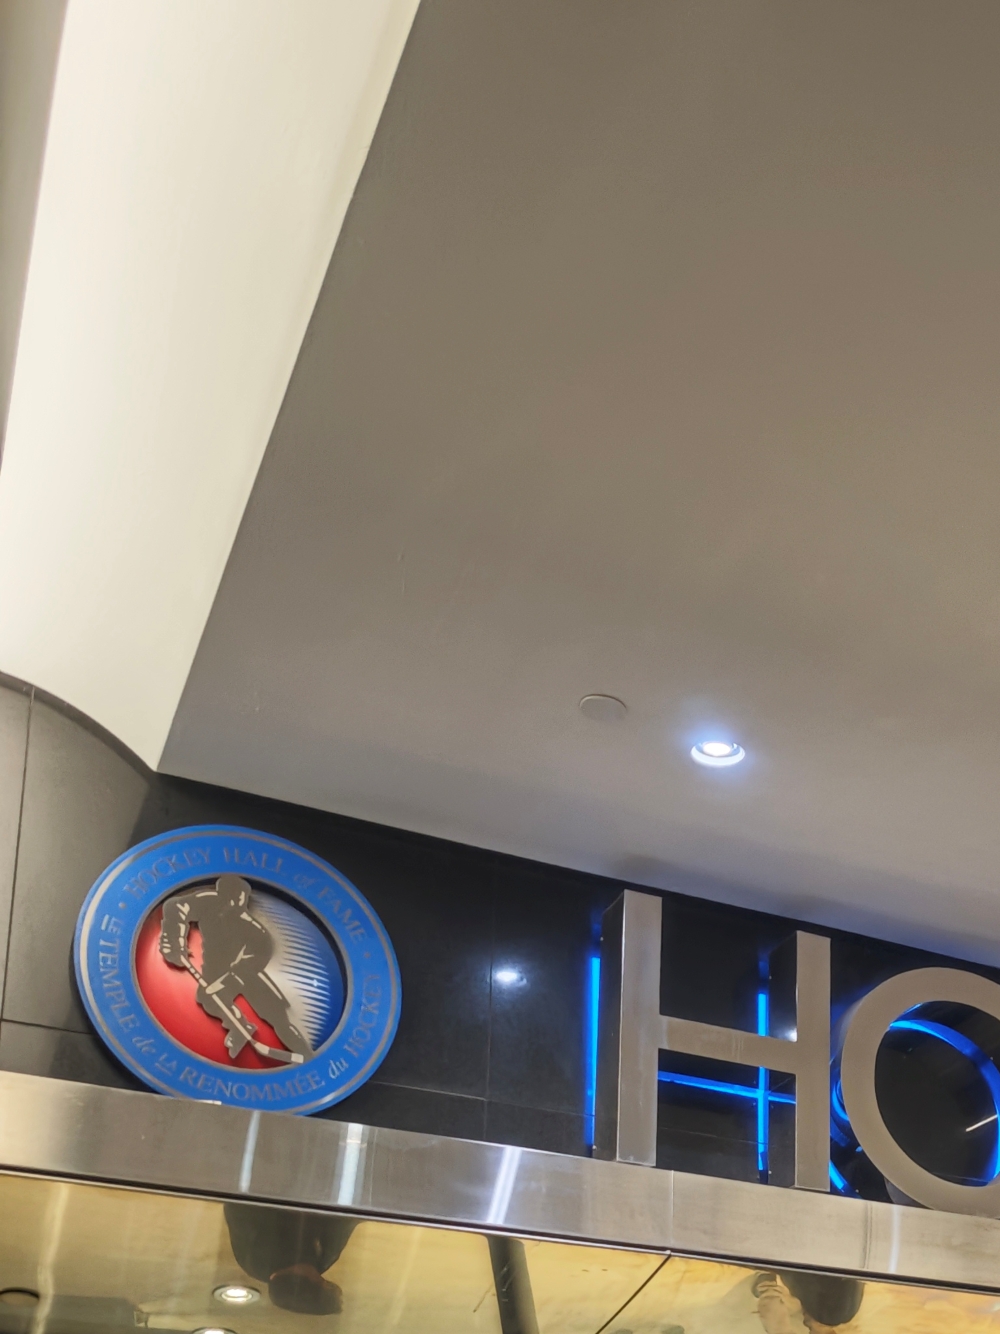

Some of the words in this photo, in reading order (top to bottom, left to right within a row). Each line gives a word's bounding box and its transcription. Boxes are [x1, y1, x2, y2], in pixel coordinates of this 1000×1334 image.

[124, 847, 211, 898] HOCKEY
[223, 848, 286, 876] HALL
[294, 863, 317, 890] of
[318, 886, 370, 945] FAME
[98, 937, 142, 1033] TEMPLE
[132, 1027, 156, 1055] de
[180, 1066, 327, 1102] RENOMMÉE
[327, 1057, 351, 1080] du
[344, 973, 382, 1058] HOCKEY
